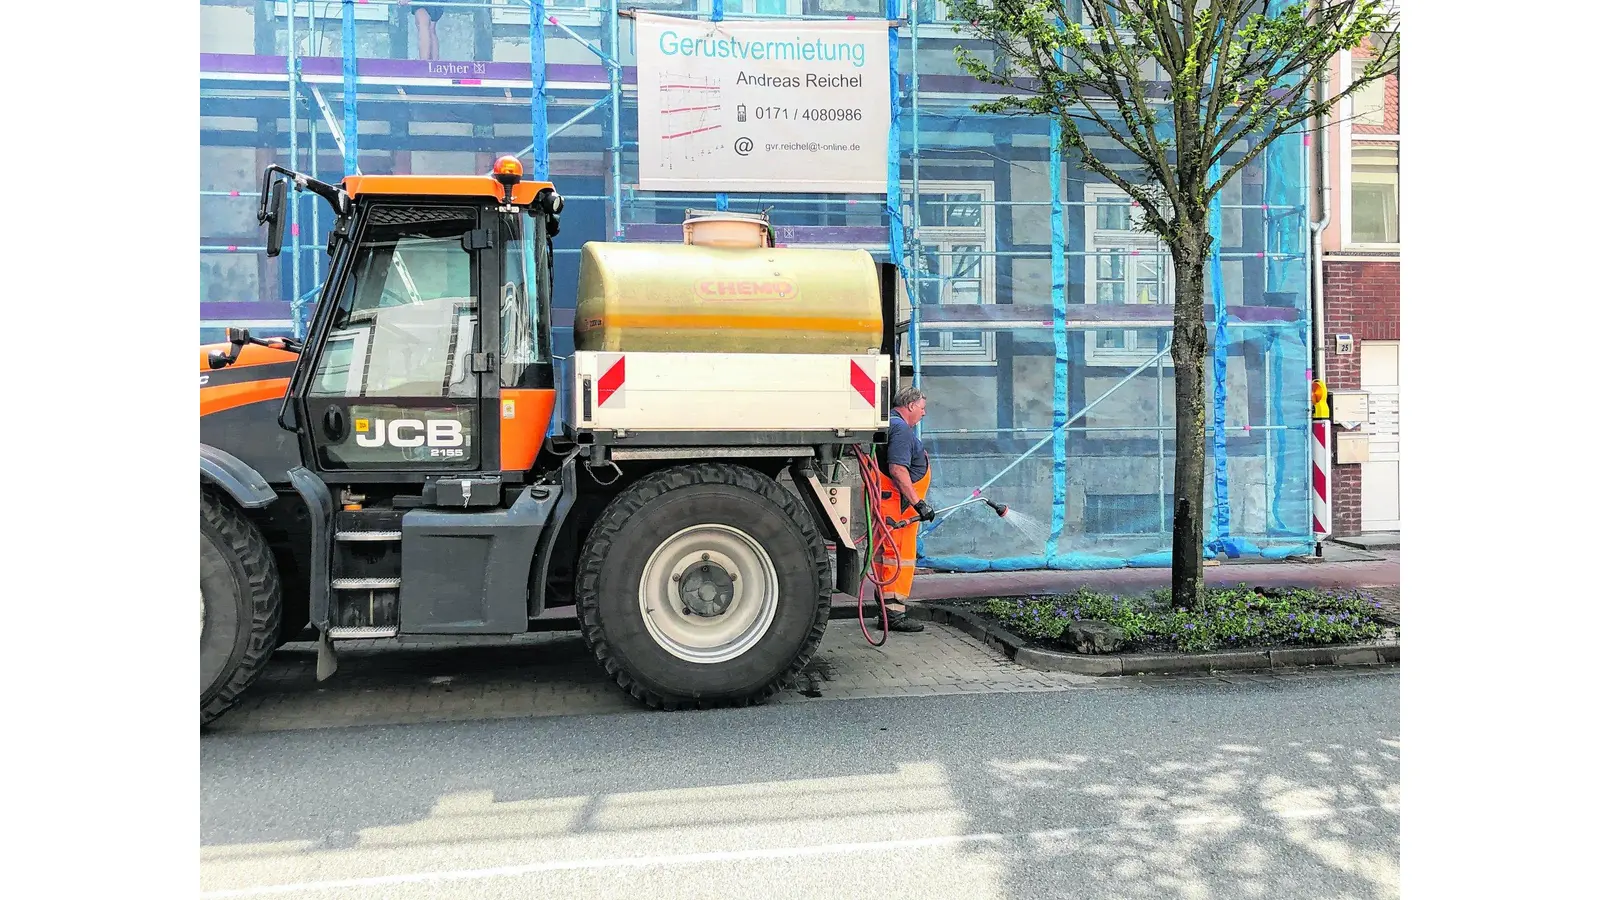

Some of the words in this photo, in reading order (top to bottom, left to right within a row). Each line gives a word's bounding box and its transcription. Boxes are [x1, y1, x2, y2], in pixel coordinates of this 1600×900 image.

[659, 31, 865, 67] Gerüstvermietung
[428, 62, 469, 75] Layher
[736, 71, 801, 88] Andreas
[805, 73, 862, 88] Reichel
[755, 106, 788, 120] 0171
[802, 108, 862, 122] 4080986
[765, 142, 861, 153] gvr.reichel@t-online.de
[700, 281, 793, 295] CHEMO
[1341, 344, 1349, 352] 25
[356, 418, 464, 448] JCB
[429, 449, 464, 457] 2155
